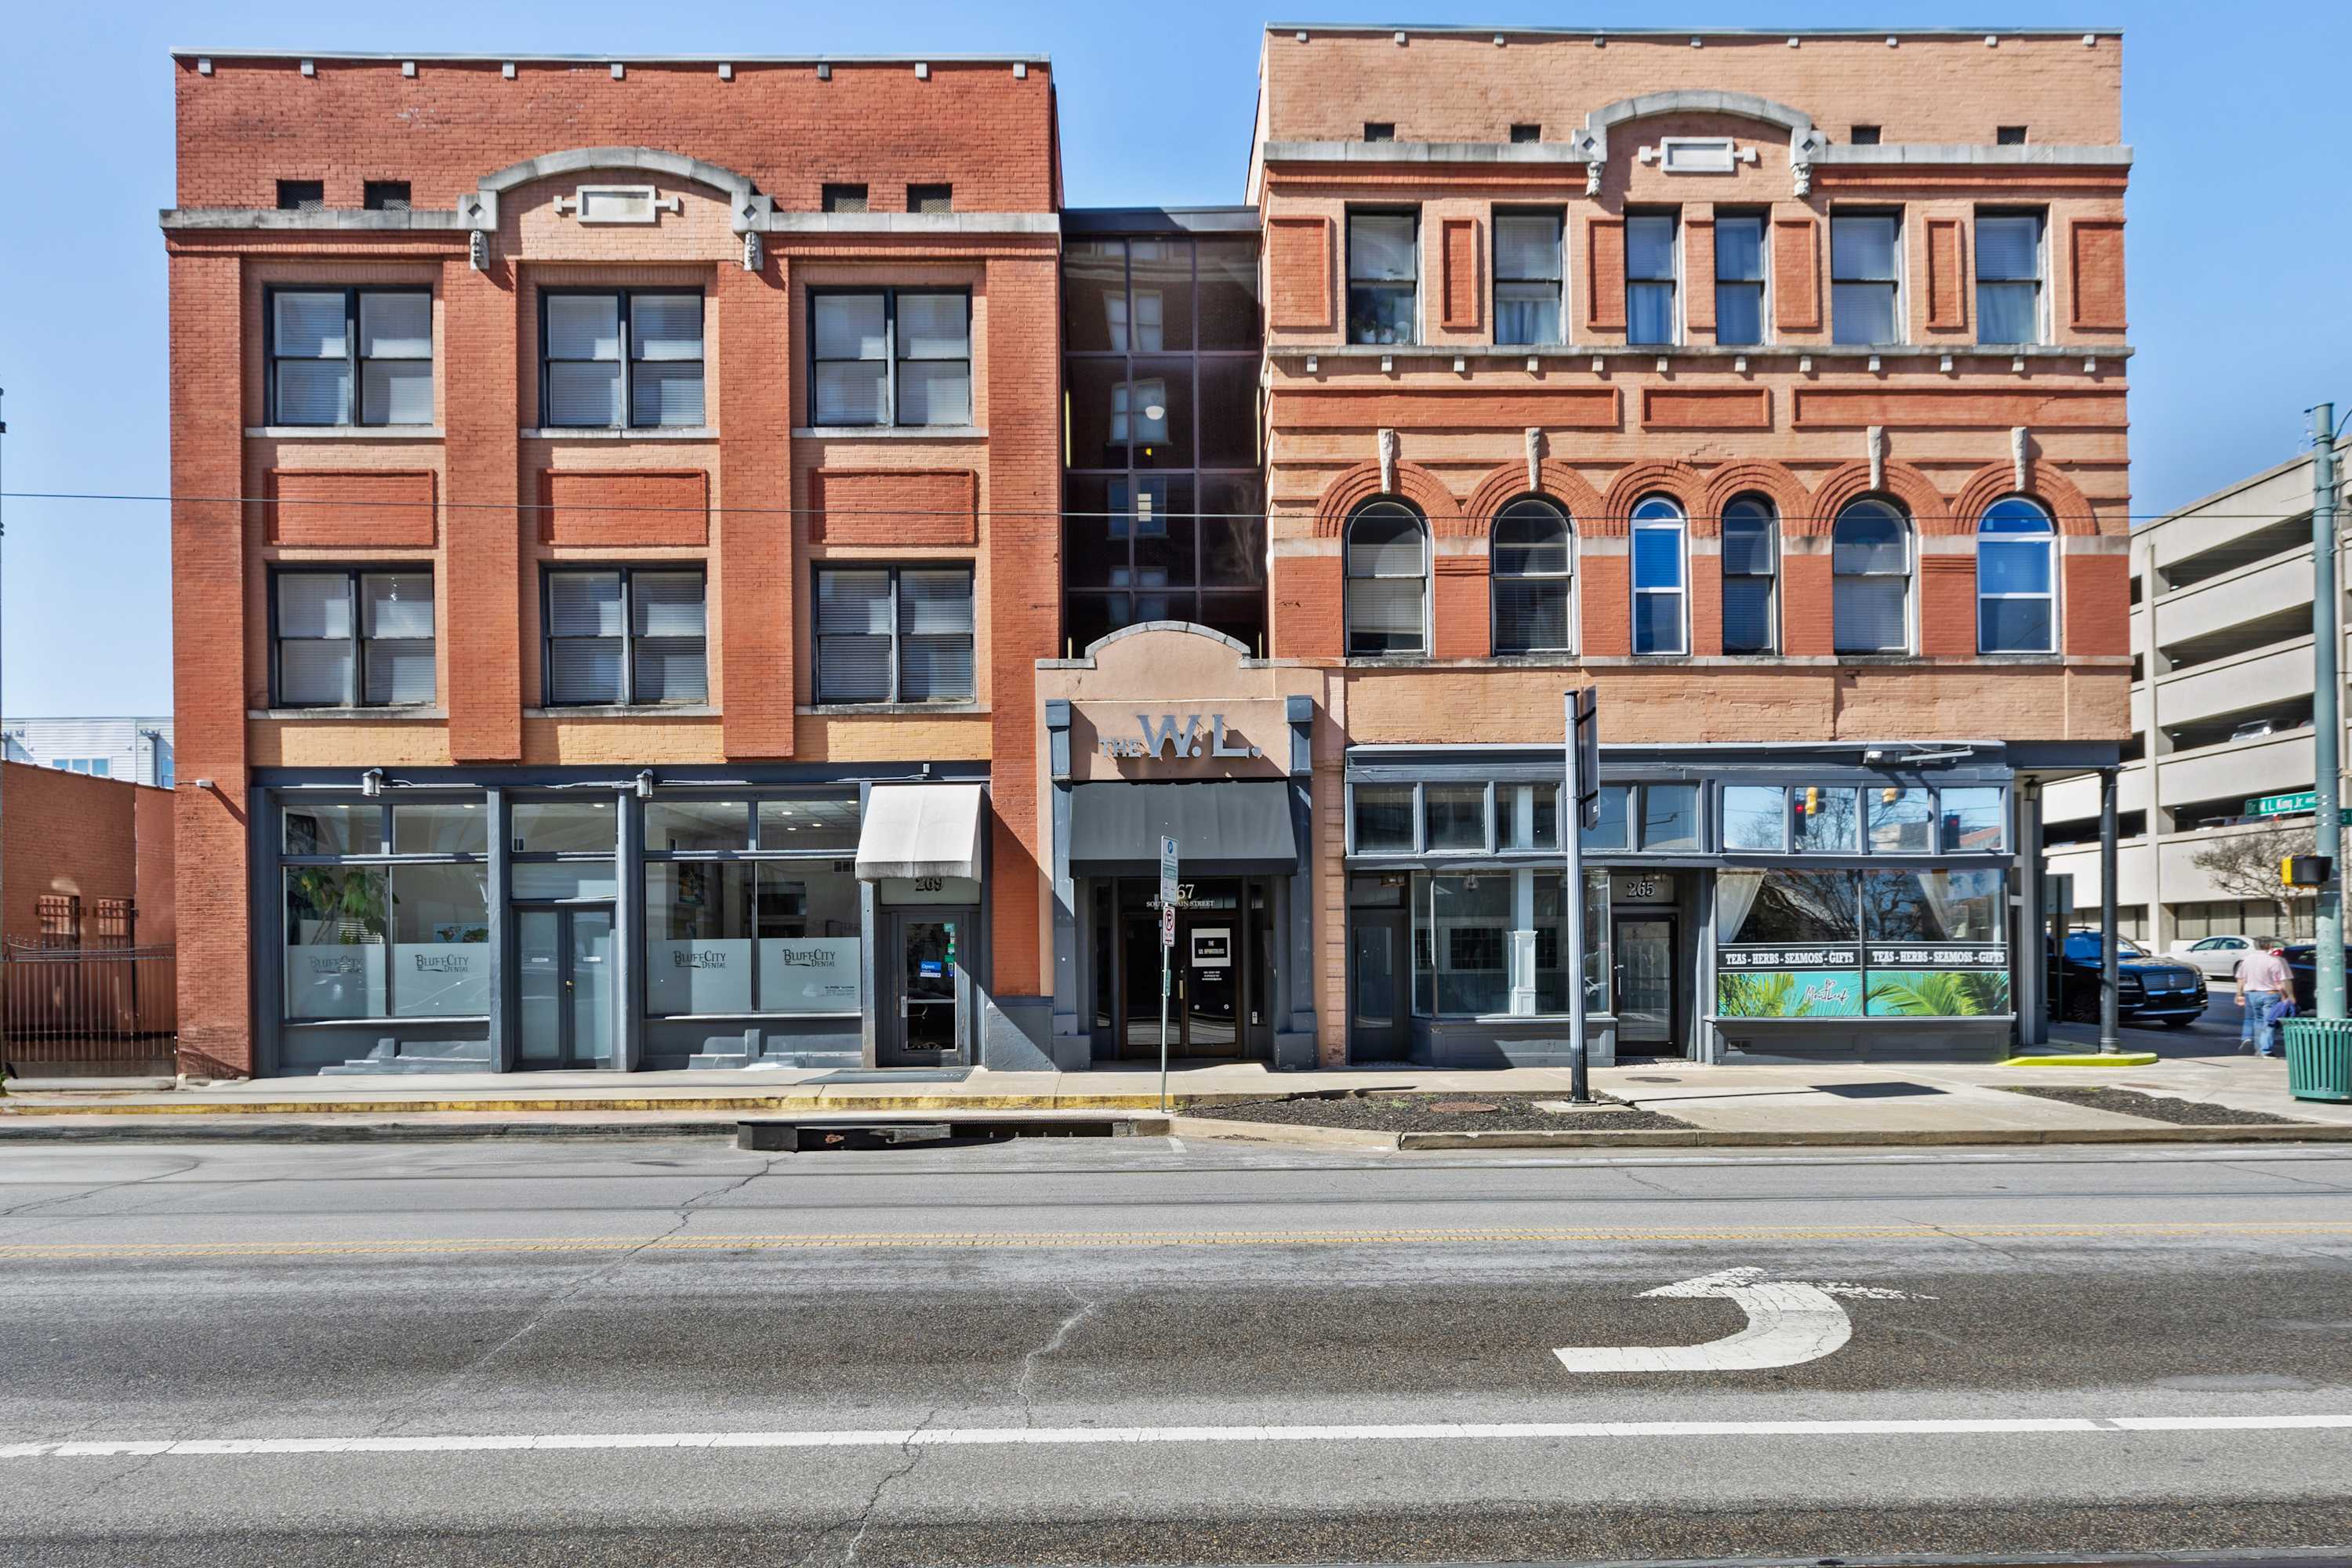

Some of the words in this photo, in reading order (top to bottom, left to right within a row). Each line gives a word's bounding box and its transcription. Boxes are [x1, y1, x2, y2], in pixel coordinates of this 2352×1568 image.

[1098, 739, 1142, 758] THE
[2276, 798, 2293, 811] King
[915, 878, 945, 891] 269
[1627, 881, 1655, 897] 265
[1177, 884, 1195, 899] 67
[1726, 953, 1747, 965] TEAS
[1752, 953, 1780, 964] HERBS
[1784, 953, 1824, 964] SEAMOSS
[1828, 952, 1855, 964] GIFTS
[1872, 951, 1894, 963] TEAS
[1900, 951, 1929, 963] HERBS
[1933, 951, 1973, 963] SEAMOSS
[1979, 952, 2005, 963] GIFTS
